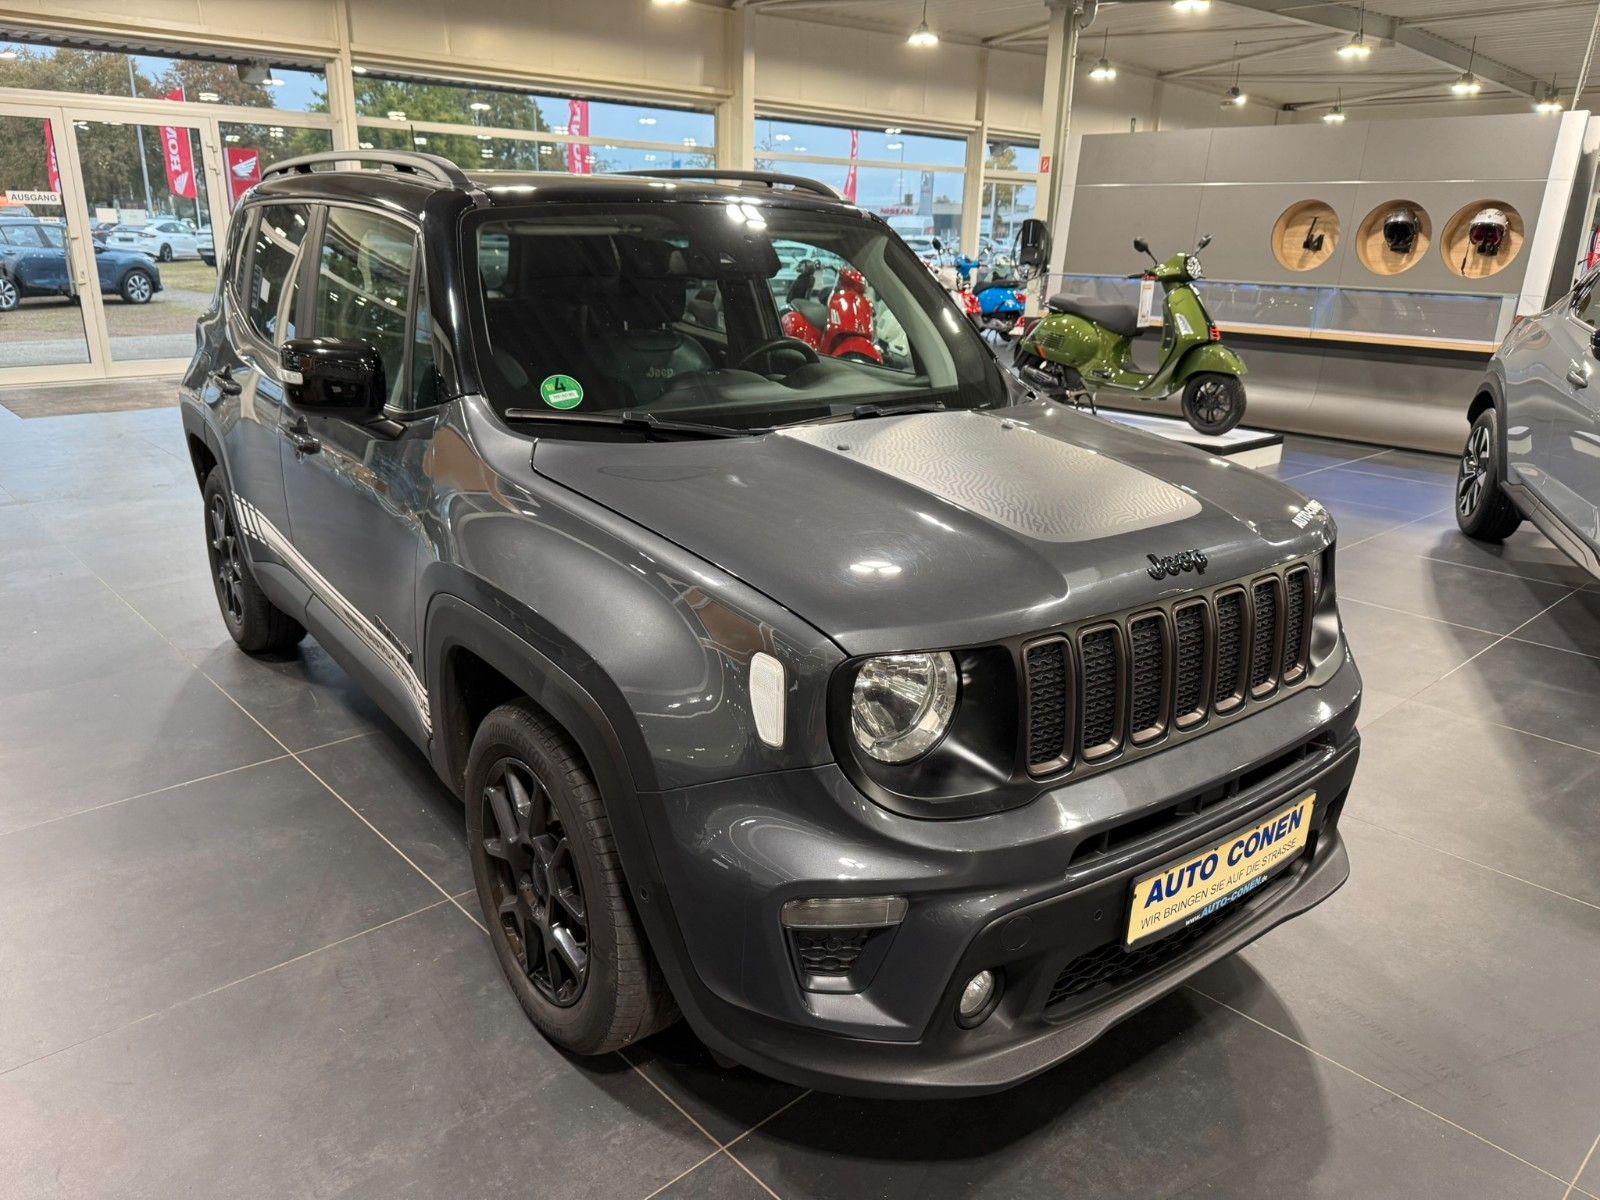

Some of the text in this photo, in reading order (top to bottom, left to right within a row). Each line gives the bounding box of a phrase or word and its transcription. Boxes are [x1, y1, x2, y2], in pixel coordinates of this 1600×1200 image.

[11, 193, 58, 202] AUSGANG
[880, 207, 914, 215] NISSAN
[646, 367, 674, 379] Jeep
[554, 377, 566, 391] 4
[1146, 548, 1208, 580] Jeep
[1144, 804, 1304, 909] AUTO CONEN
[1140, 837, 1298, 930] WIR BRINGEN SIE AUF DIE STRASSE
